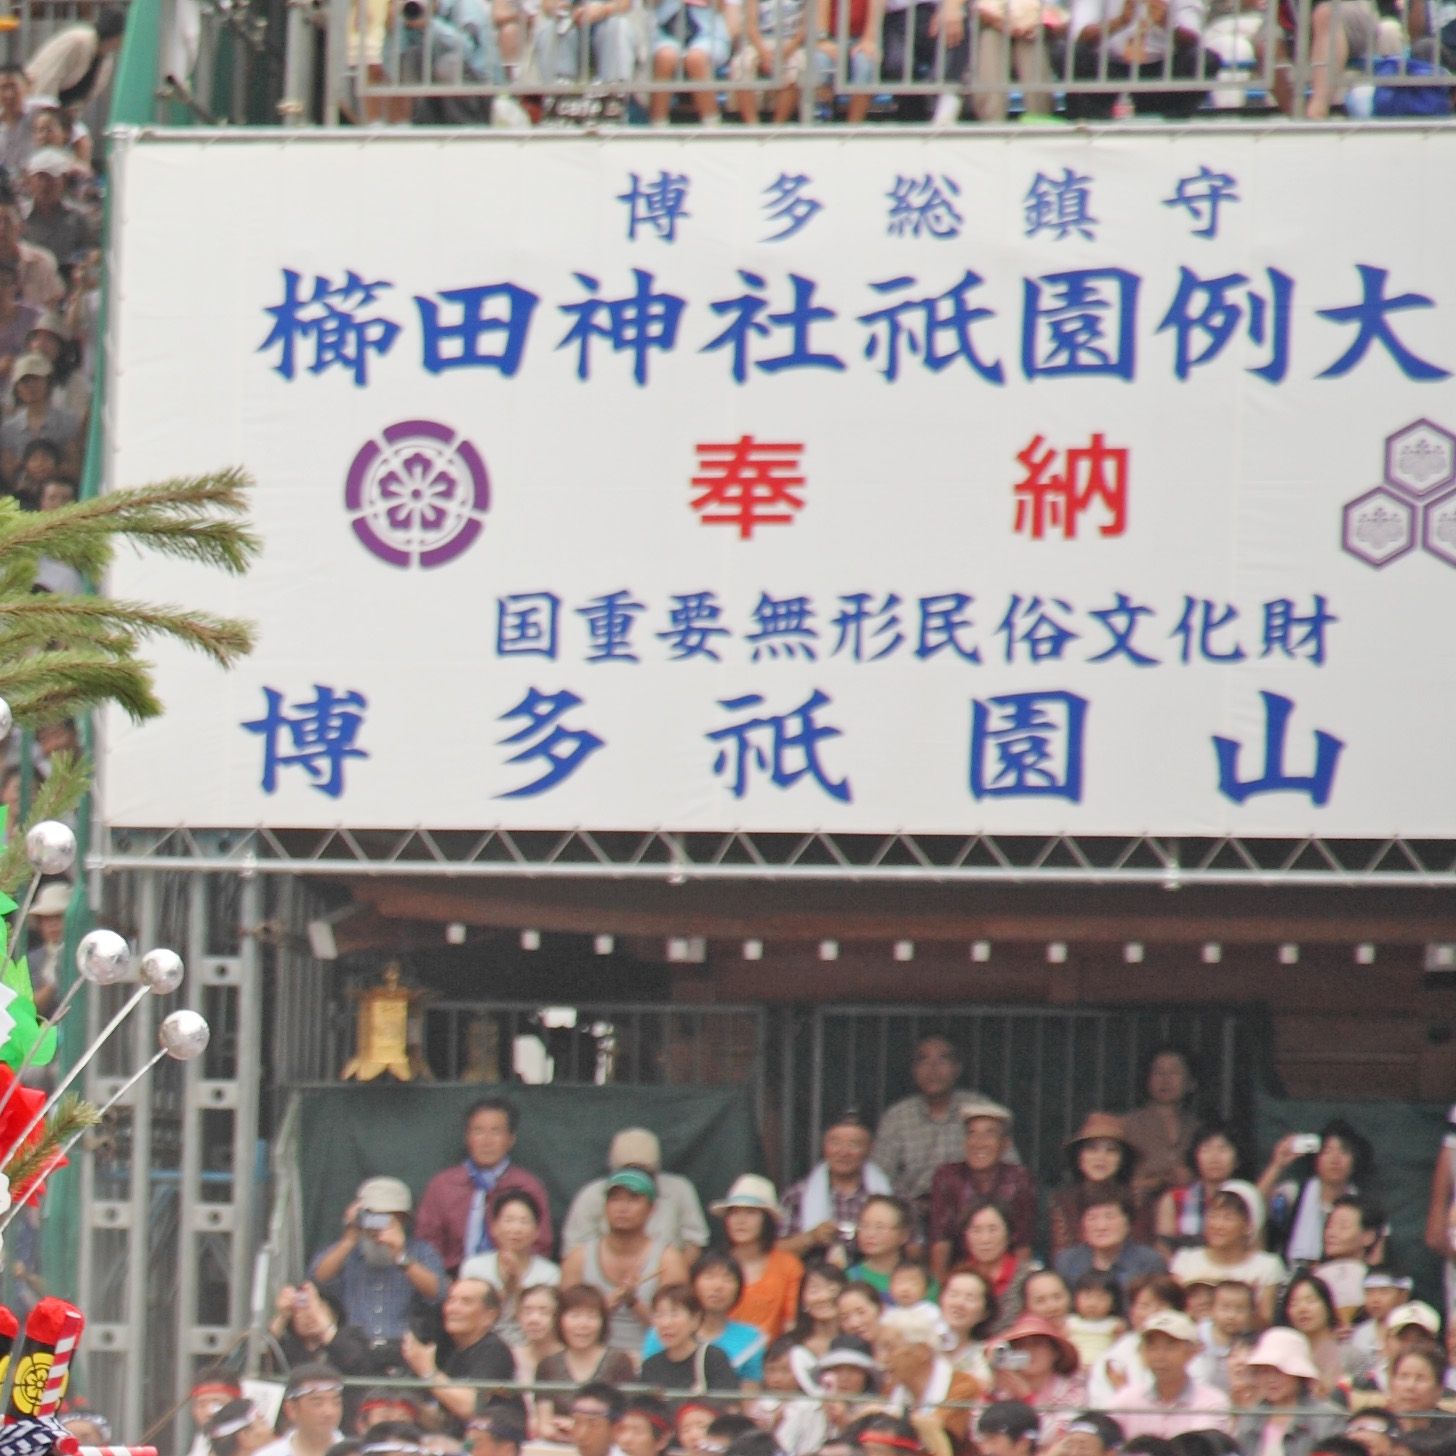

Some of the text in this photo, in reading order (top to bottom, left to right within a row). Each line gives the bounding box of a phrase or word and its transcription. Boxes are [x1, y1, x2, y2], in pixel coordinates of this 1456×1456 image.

[619, 166, 1240, 242] 博多総鎮守
[690, 434, 1129, 540] 奉納
[494, 591, 1338, 667] 国重要無形民俗文化財
[241, 686, 1345, 807] 博多祇園山
